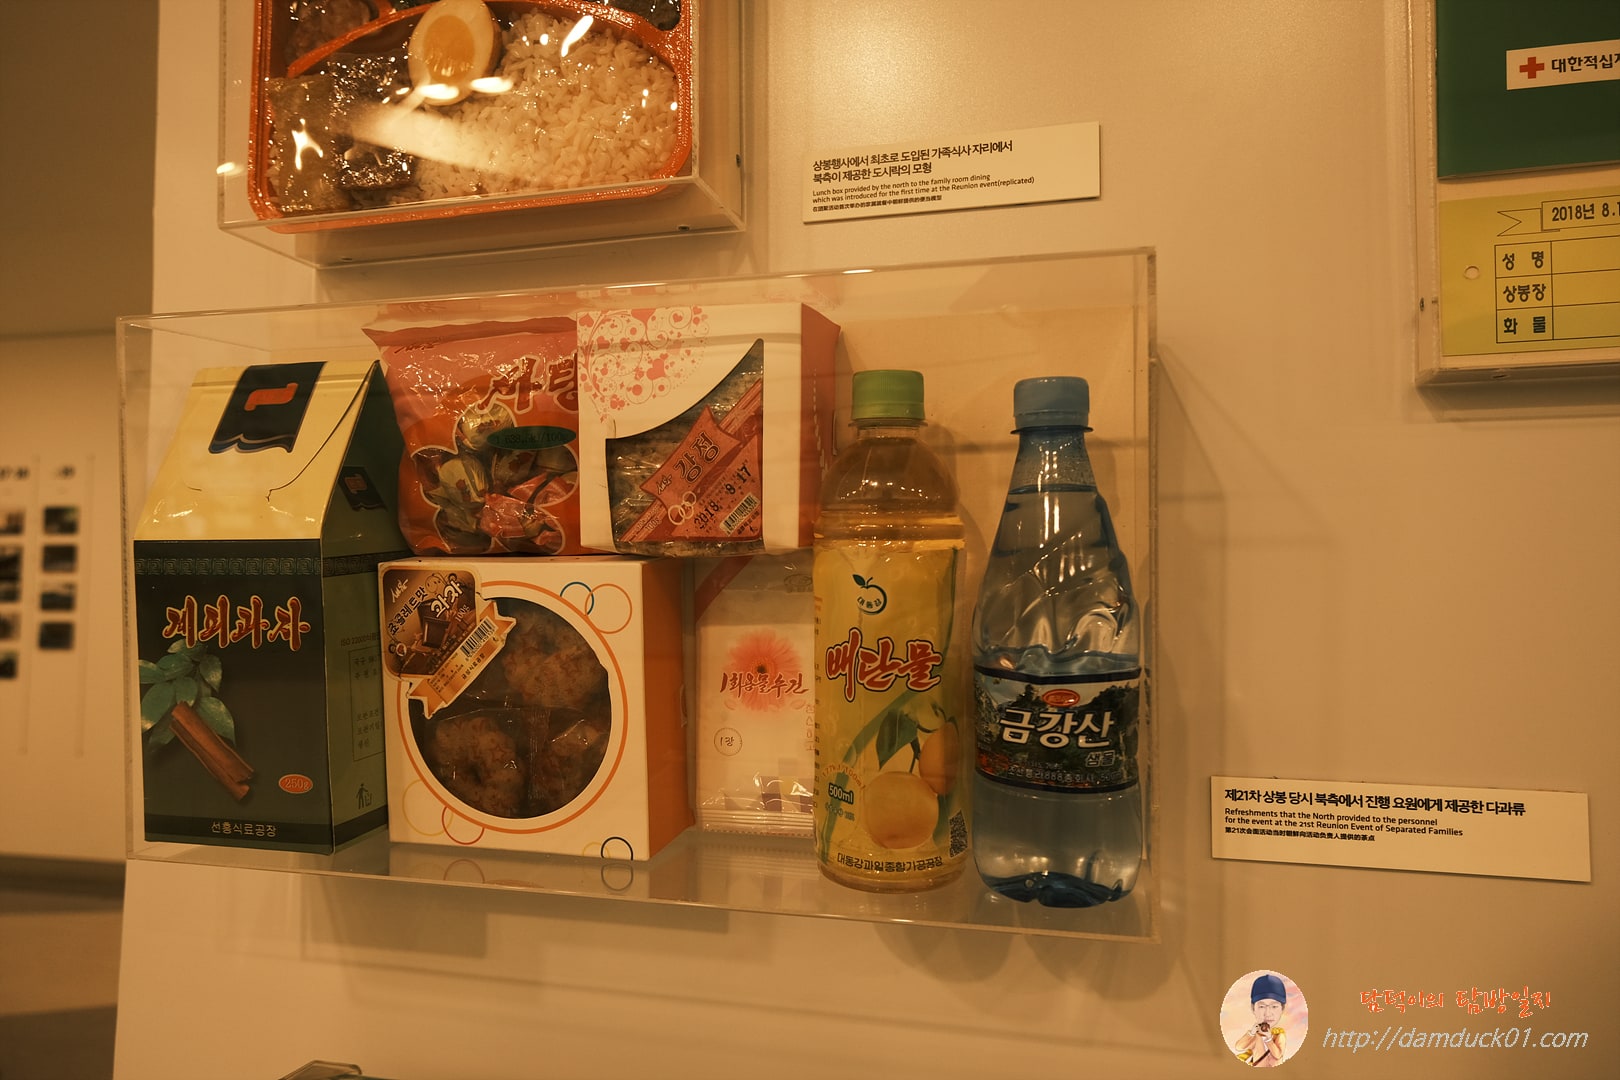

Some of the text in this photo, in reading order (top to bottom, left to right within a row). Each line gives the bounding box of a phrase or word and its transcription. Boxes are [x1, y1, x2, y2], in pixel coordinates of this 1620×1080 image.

[813, 140, 1013, 171] 상봉행사에서 최초로 도입된 가족식사 자리에서
[813, 162, 932, 184] 북측이 제공한 도시락의 모형
[813, 189, 831, 197] Lunch
[844, 185, 870, 197] provided
[871, 184, 879, 192] by
[892, 181, 910, 189] north
[919, 179, 930, 187] the
[930, 177, 951, 186] family
[952, 175, 969, 183] room
[970, 174, 991, 183] dining
[813, 196, 831, 204] which
[844, 192, 878, 201] introduced
[878, 190, 888, 198] for
[889, 189, 900, 197] the
[900, 188, 914, 196] first
[915, 187, 930, 195] time
[939, 184, 951, 192] the
[951, 182, 979, 191] Reunion
[979, 176, 1035, 188] event(replicated)
[1551, 203, 1595, 222] 2018년
[1502, 250, 1545, 271] 성 명
[1503, 282, 1547, 304] 상봉장
[1503, 317, 1518, 335] 화
[674, 432, 720, 483] 강정
[430, 580, 463, 618] 과자
[162, 595, 311, 651] 계피과자
[455, 604, 471, 622] 100g
[826, 627, 943, 702] 배단물
[1000, 708, 1115, 750] 금강산
[1085, 749, 1116, 768] 샘물
[284, 777, 309, 791] 250g
[828, 783, 855, 806] 500ml
[1225, 788, 1526, 816] 제21차 상봉 당시 북측에서 진행 요원에게 제공한 다과류
[1225, 808, 1278, 818] Refreshments
[1279, 811, 1296, 819] that
[1298, 812, 1311, 820] the
[1312, 813, 1335, 821] North
[1336, 814, 1371, 824] provided
[1383, 816, 1396, 824] the
[1398, 818, 1438, 827] personnel
[1225, 816, 1236, 824] for
[1237, 817, 1250, 825] the
[1274, 819, 1283, 827] at
[1284, 819, 1297, 827] the
[1316, 821, 1349, 830] Reunion
[1350, 823, 1373, 831] Event
[1375, 824, 1384, 832] of
[1385, 825, 1427, 835] Separated
[1428, 827, 1464, 836] Families
[211, 821, 277, 838] 선흥식료공장
